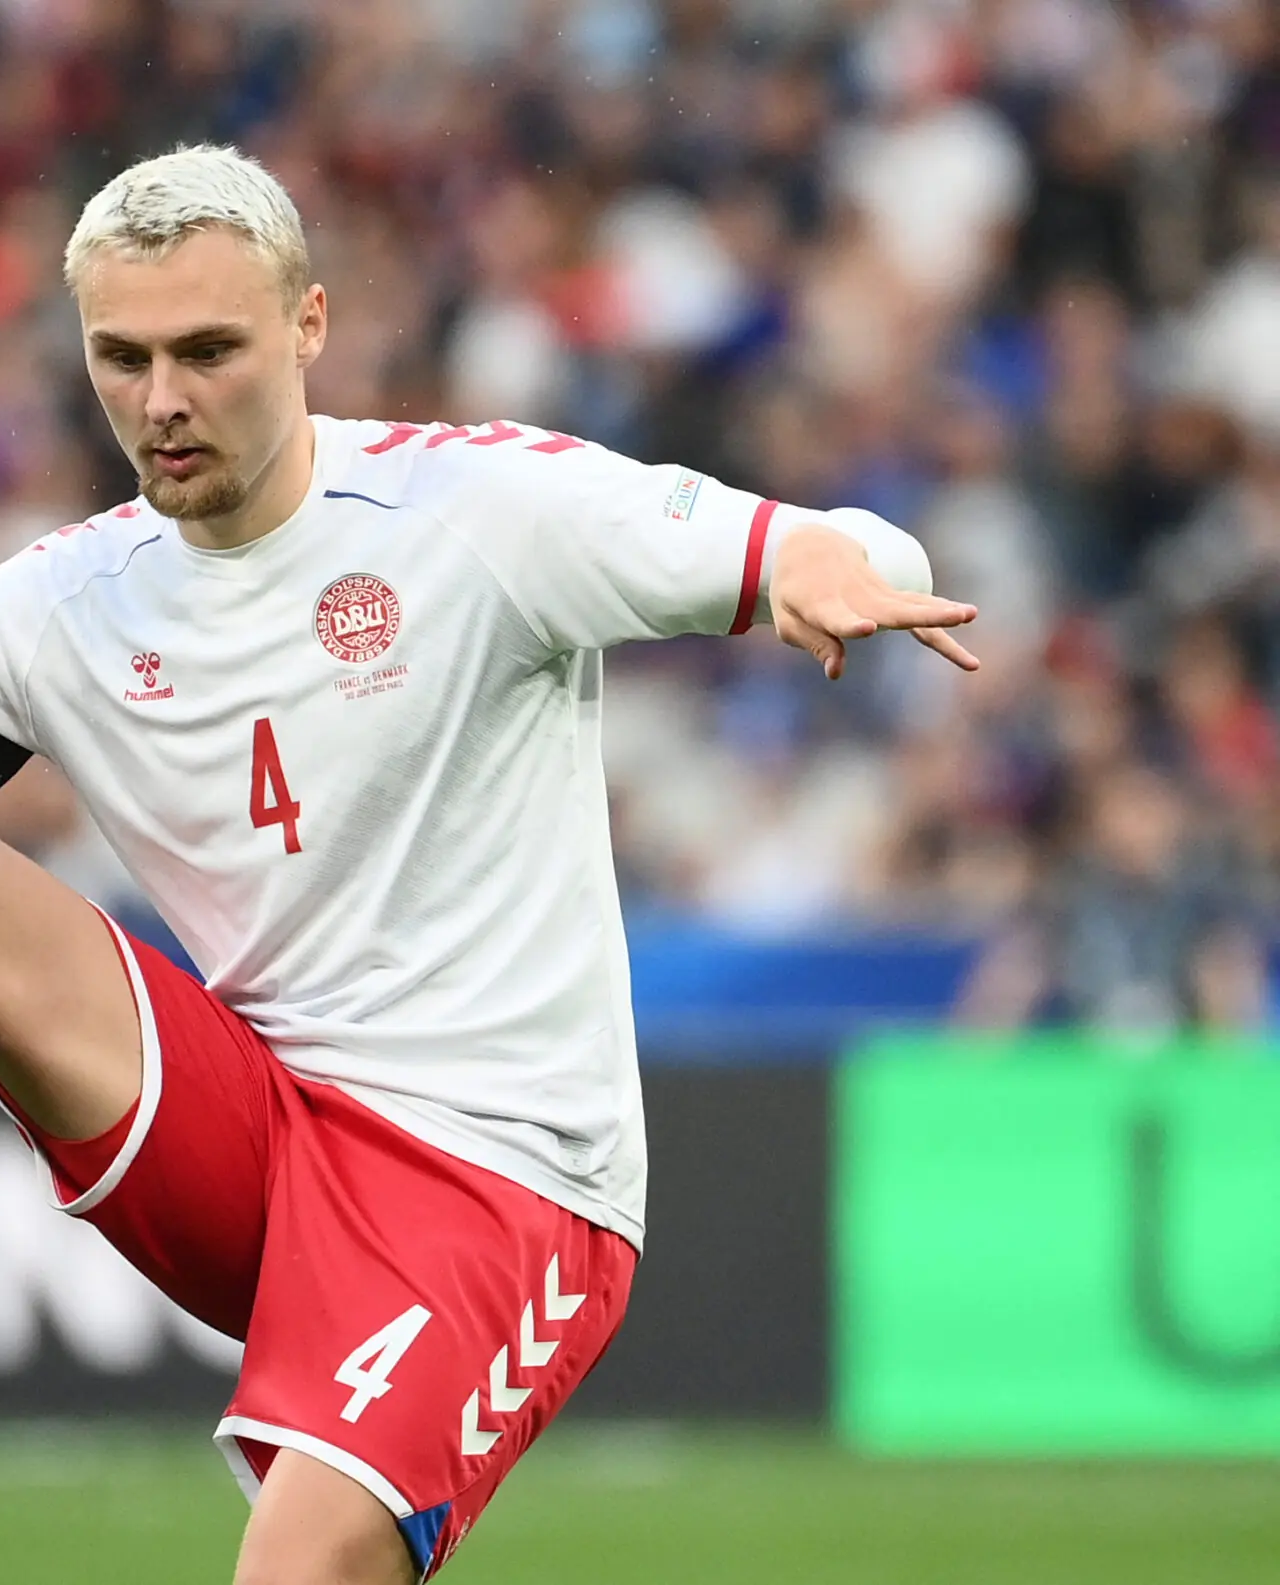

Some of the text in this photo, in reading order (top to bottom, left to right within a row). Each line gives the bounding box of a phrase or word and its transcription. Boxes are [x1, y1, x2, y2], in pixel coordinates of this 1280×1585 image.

[317, 609, 345, 657] DANSK
[383, 594, 400, 643] UNION
[332, 601, 386, 637] DBU
[348, 644, 383, 661] 1889
[124, 683, 174, 701] hummel
[334, 676, 360, 692] FRANCE
[372, 663, 409, 682] DENMARK
[250, 717, 302, 854] 4
[334, 1303, 432, 1423] 4
